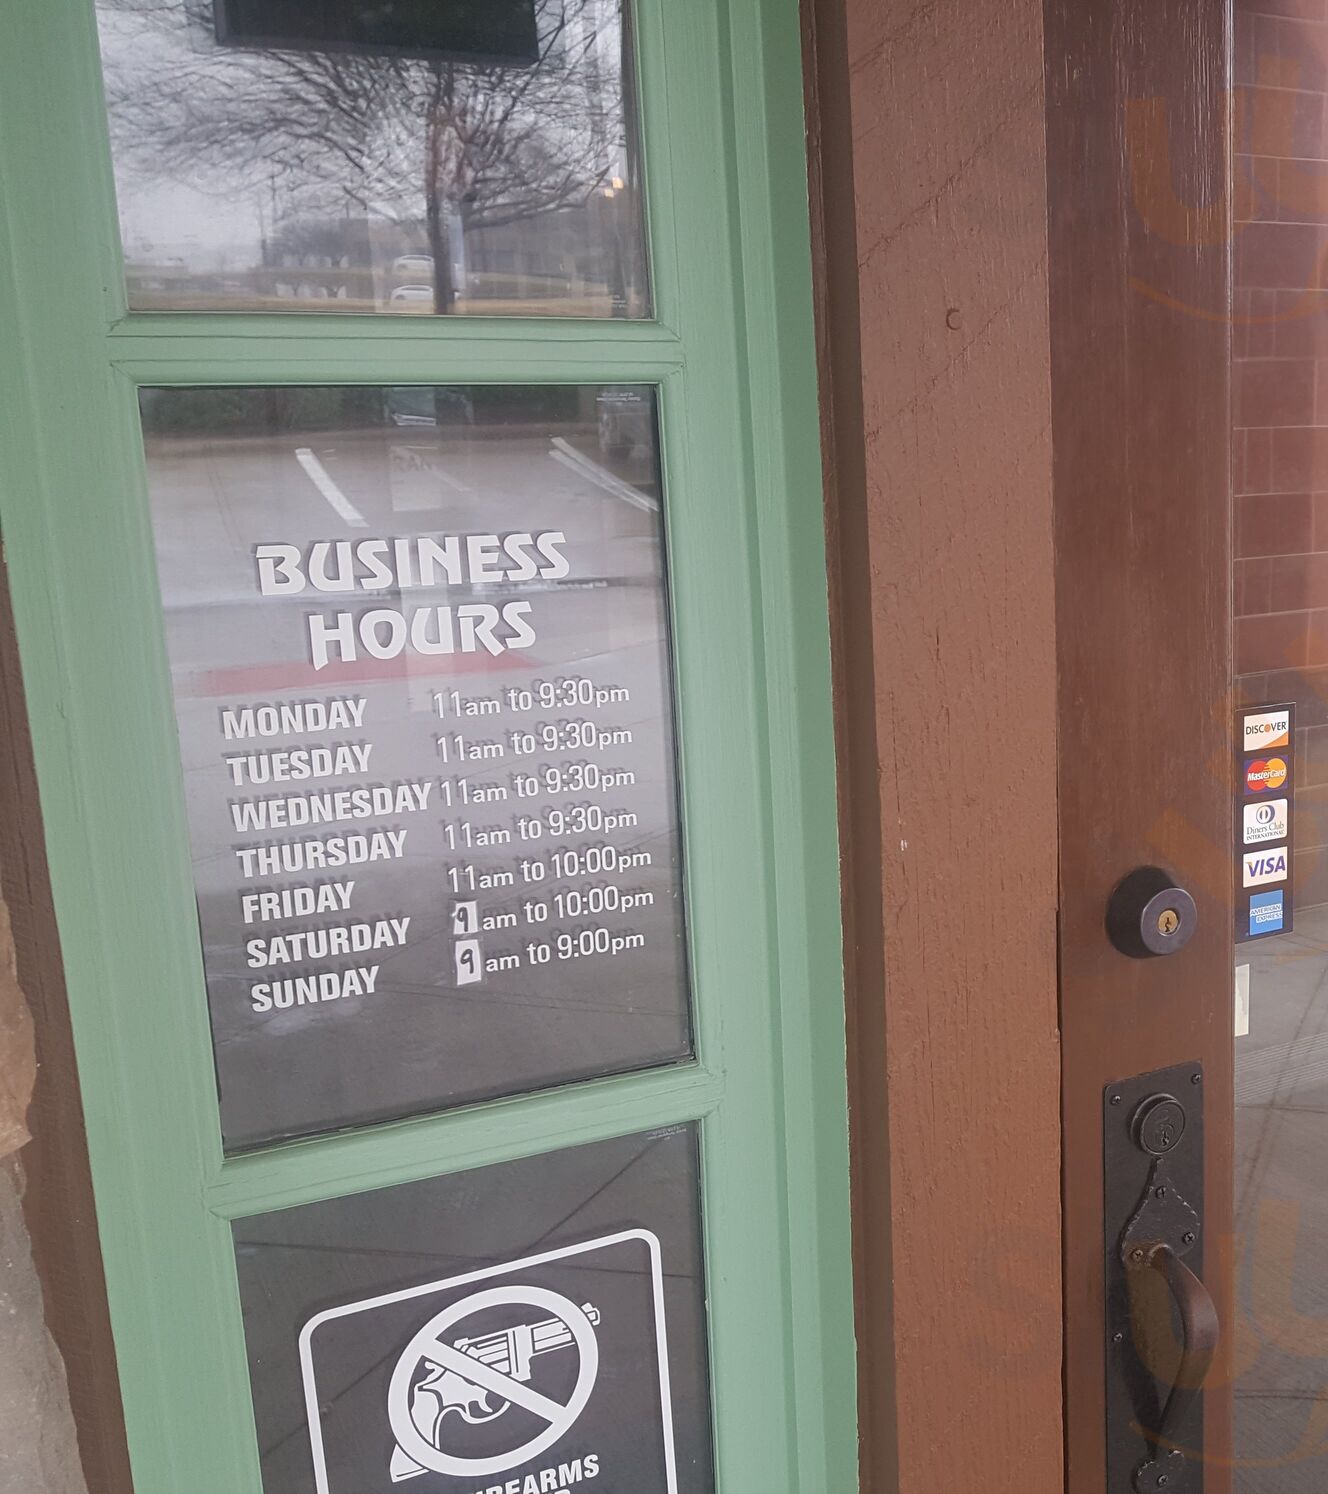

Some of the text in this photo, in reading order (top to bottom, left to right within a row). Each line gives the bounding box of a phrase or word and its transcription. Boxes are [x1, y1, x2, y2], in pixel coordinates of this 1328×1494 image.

[256, 532, 570, 596] BUSINESS
[309, 601, 537, 671] HOURS
[222, 679, 630, 740] MONDAY 11am to 9:30pm
[1245, 721, 1286, 735] DISCOVER
[226, 722, 633, 786] TUESDAY 11am to 9:30pm
[1247, 767, 1287, 782] MasterCard
[232, 764, 635, 832] WEDNESDAY 11am to 9:30pm
[1247, 821, 1284, 835] Diners Club
[236, 805, 638, 878] THURSDAY 11am to 9:30pm
[1246, 855, 1286, 878] VISA
[242, 846, 652, 923] FRIDAY 11am to 10:00pm
[246, 917, 411, 968] SATURDAY
[483, 910, 517, 931] am
[524, 900, 549, 922] to
[554, 886, 654, 914] 10:00pm
[251, 966, 380, 1013] SUNDAY
[486, 951, 520, 973] am
[527, 941, 551, 963] to
[557, 928, 646, 959] 9:00pm
